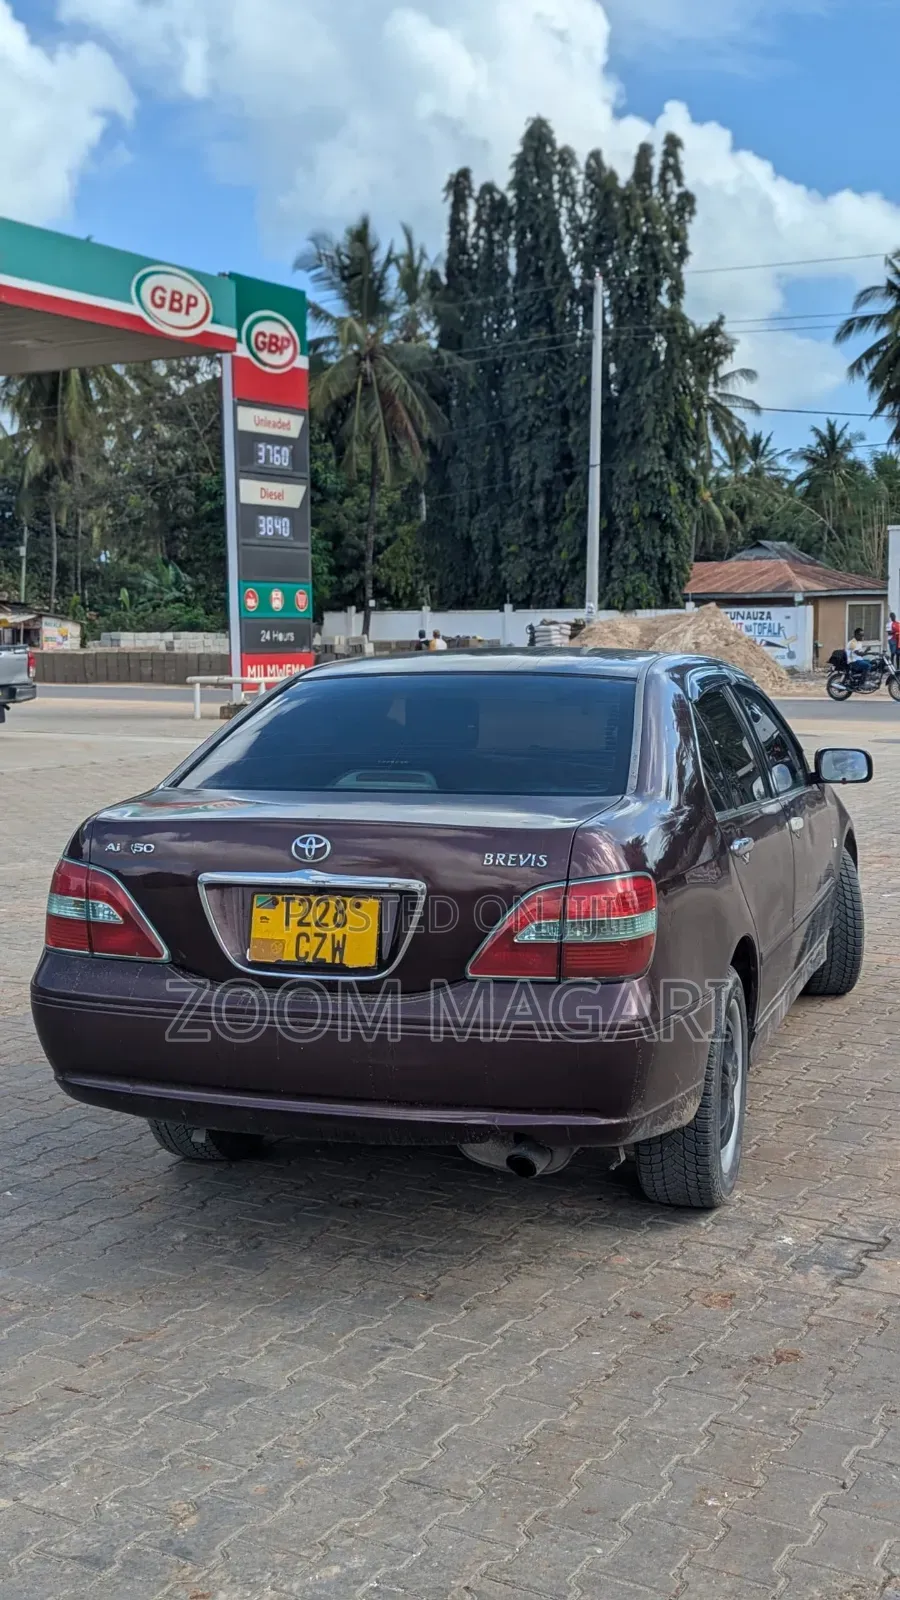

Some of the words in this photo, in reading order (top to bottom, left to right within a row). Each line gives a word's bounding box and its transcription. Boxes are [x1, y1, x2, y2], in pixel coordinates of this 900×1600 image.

[150, 285, 199, 317] GBP
[253, 330, 291, 356] GBP
[253, 414, 291, 431] Unleaded
[257, 445, 290, 467] 3760
[259, 487, 285, 501] Diesel
[258, 515, 290, 537] 3840
[260, 629, 271, 642] 24
[272, 630, 295, 642] Hours
[483, 851, 548, 869] BREVIS
[281, 896, 348, 929] T228
[294, 932, 347, 964] CZW
